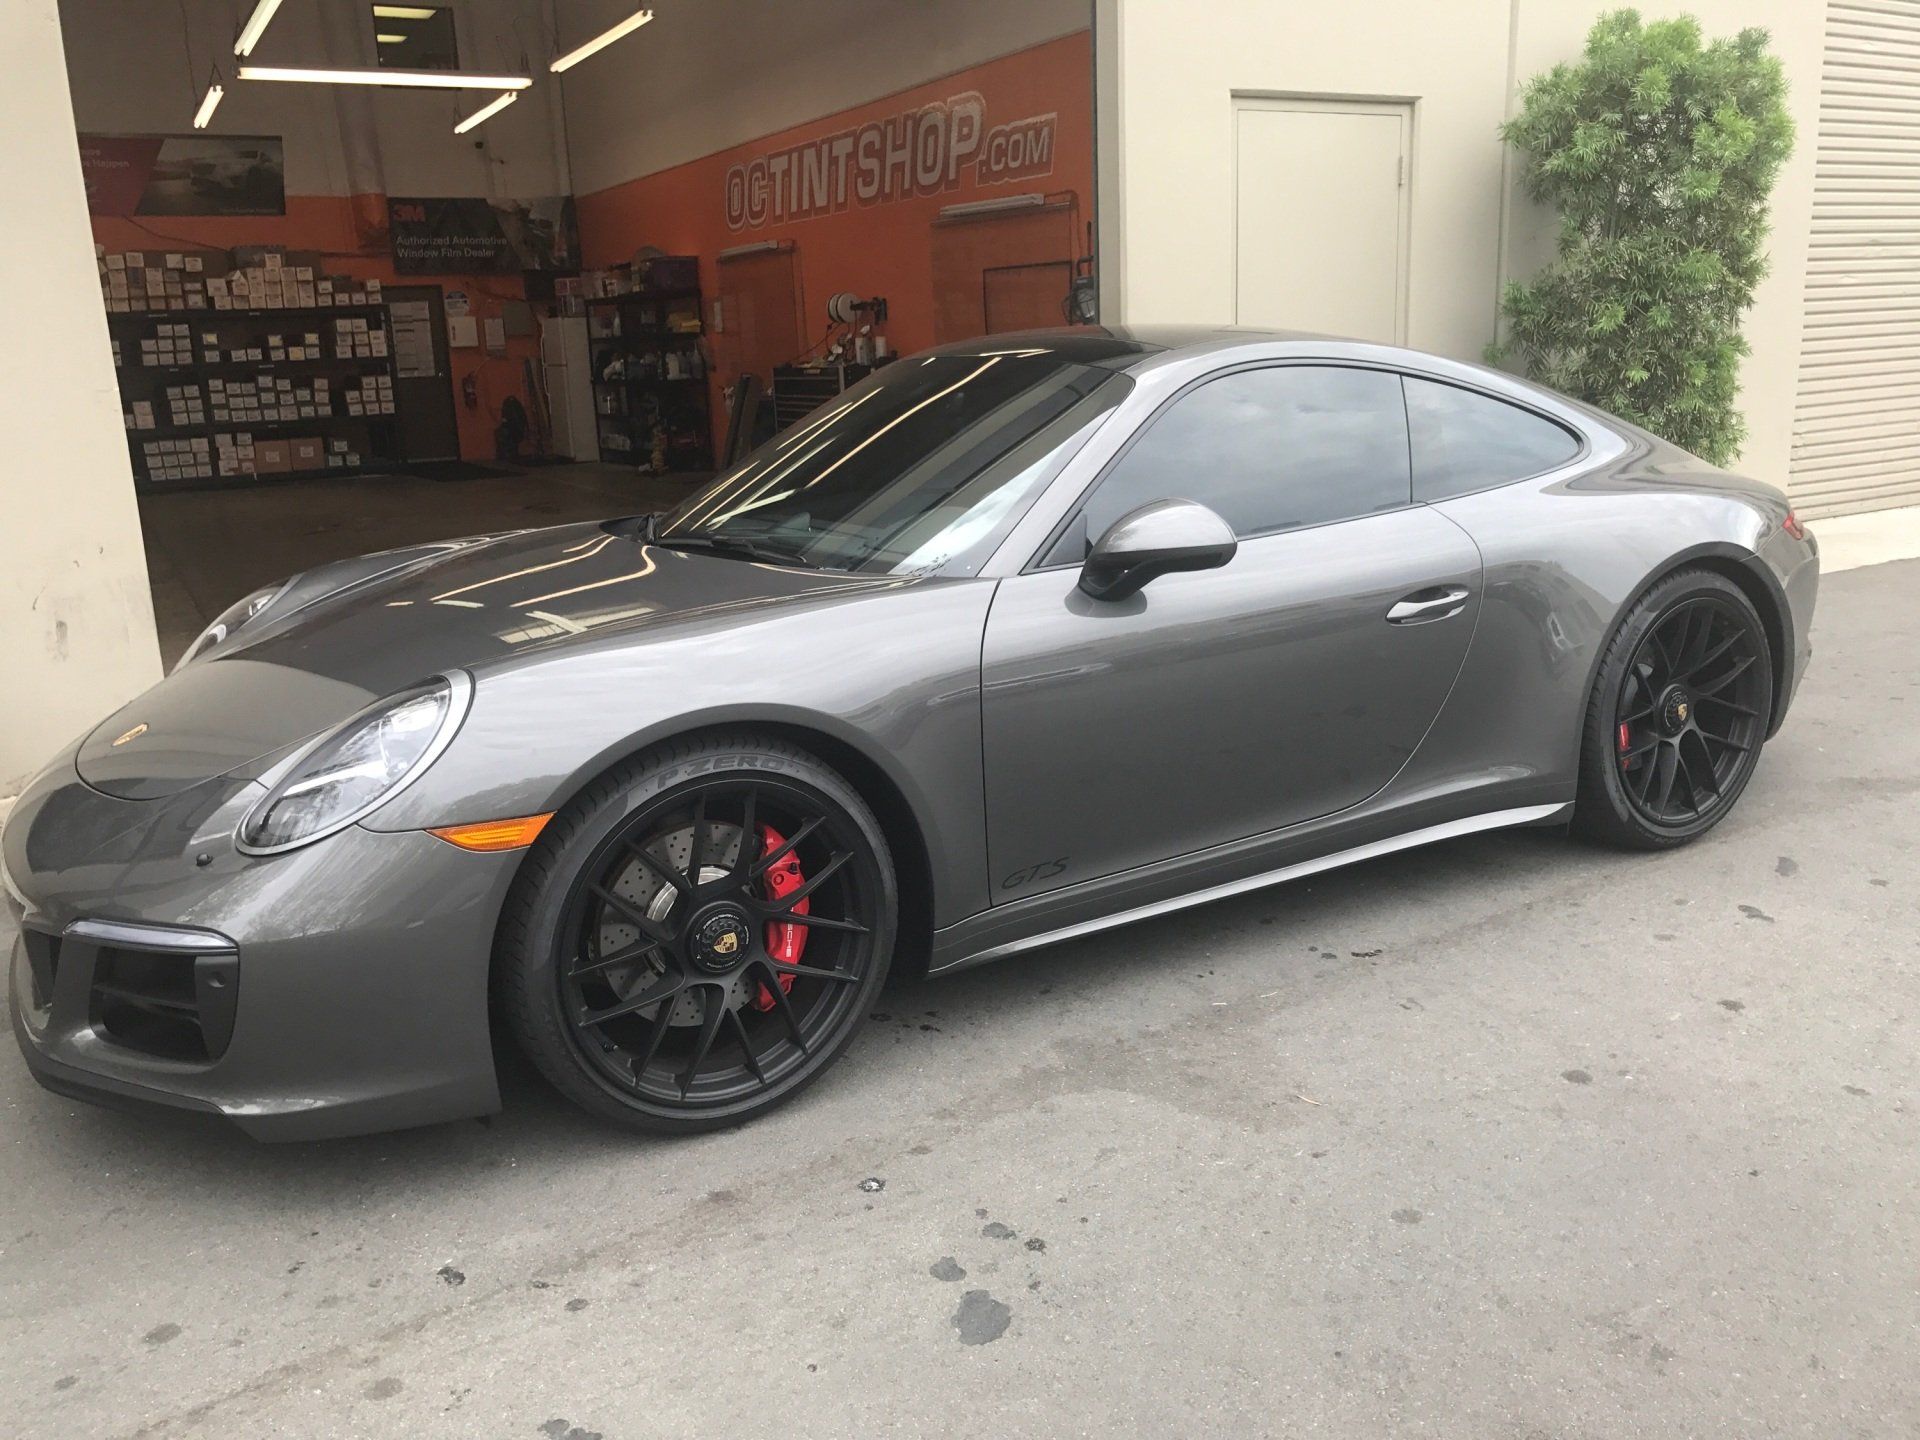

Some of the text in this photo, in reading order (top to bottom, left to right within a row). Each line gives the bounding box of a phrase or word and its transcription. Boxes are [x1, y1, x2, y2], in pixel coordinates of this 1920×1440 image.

[394, 204, 426, 223] 3M
[396, 235, 508, 246] Authorized Automotive
[397, 247, 495, 258] Window Film Dealer
[1001, 856, 1071, 890] GTS
